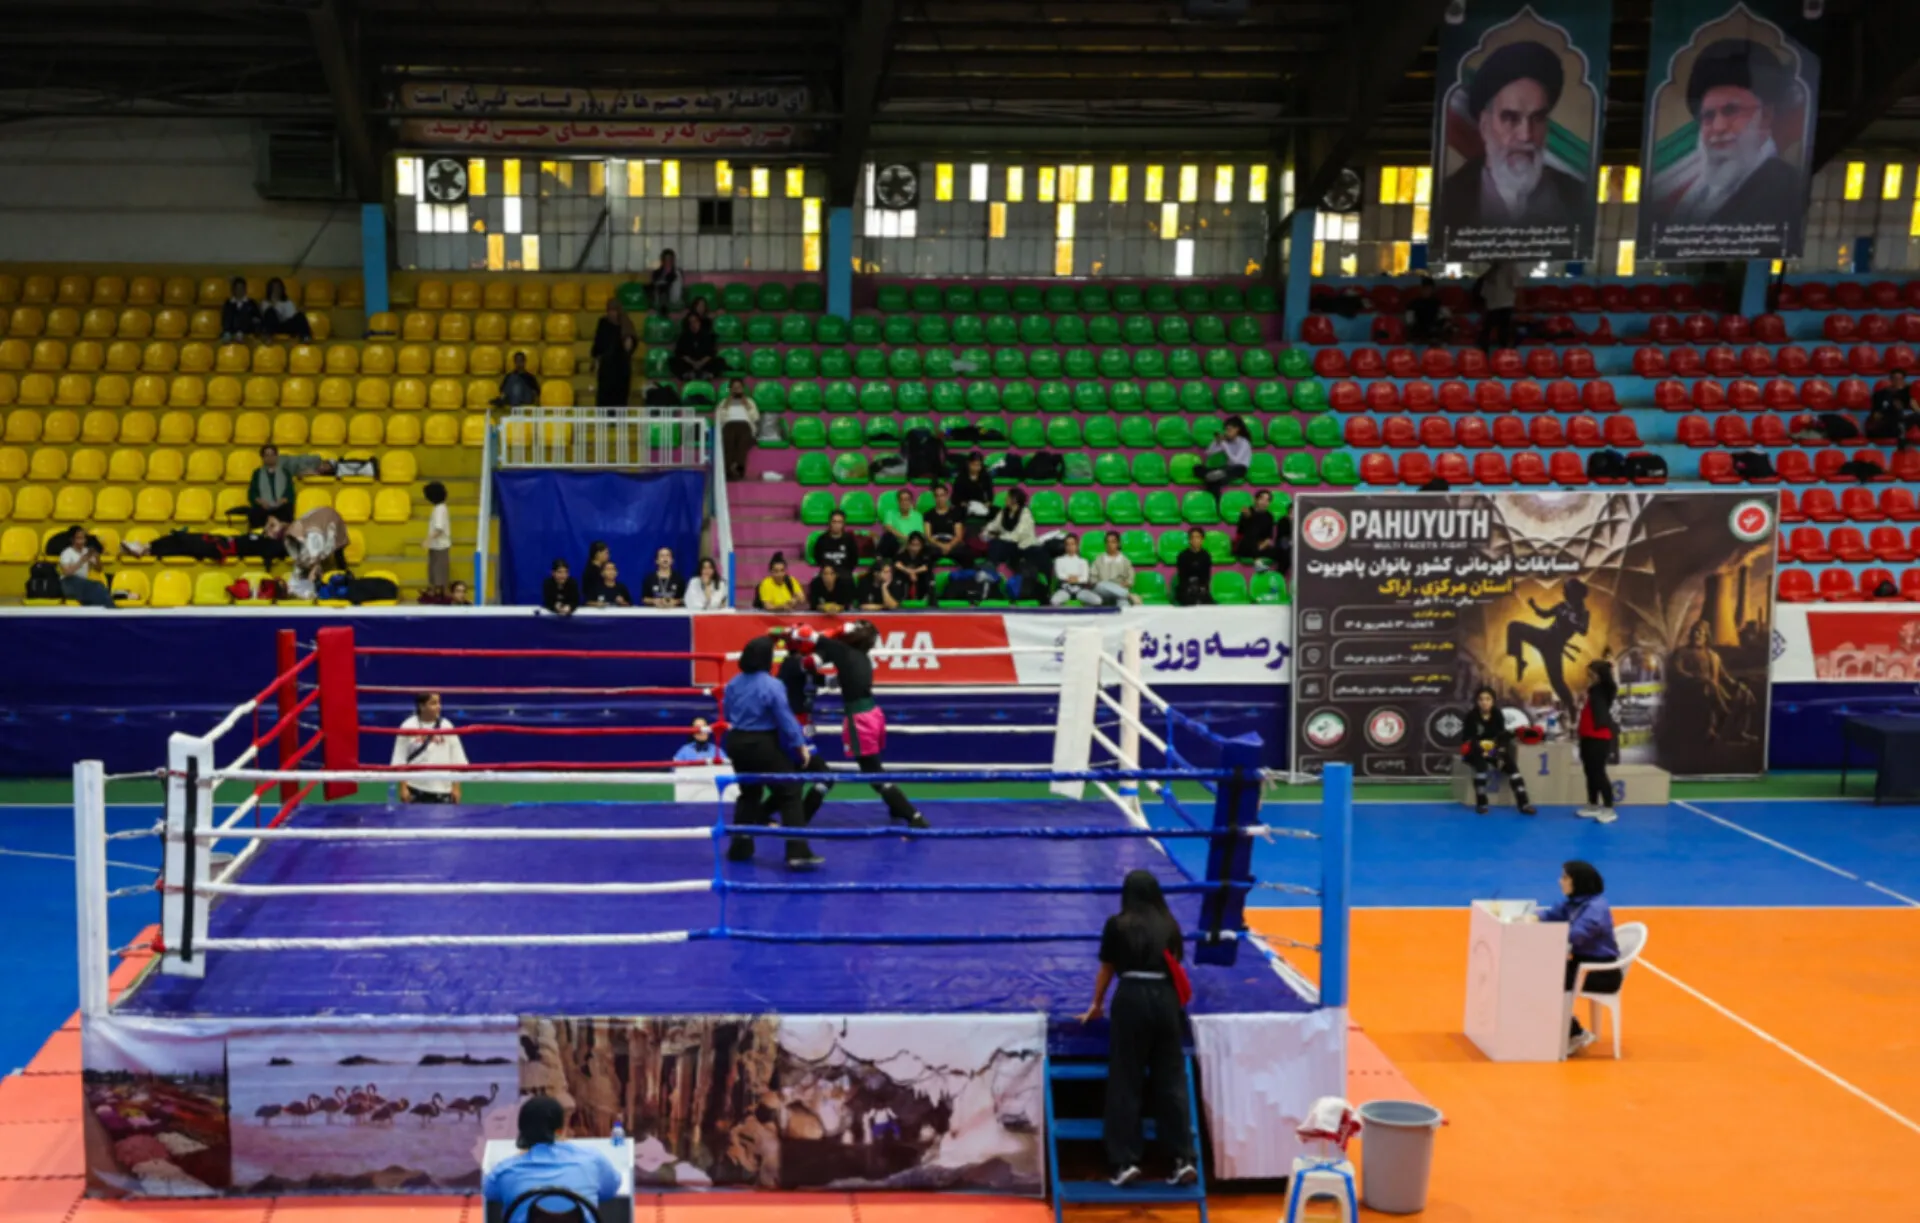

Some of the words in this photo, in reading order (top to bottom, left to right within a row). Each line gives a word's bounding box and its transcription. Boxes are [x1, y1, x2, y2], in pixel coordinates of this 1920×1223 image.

[1349, 509, 1489, 539] PAHUYUTH
[1373, 541, 1401, 549] MULTI
[1404, 541, 1438, 549] FACETS
[1441, 541, 1468, 549] FIGHT
[1306, 556, 1366, 577] پاهویوت
[1368, 556, 1411, 576] بانوان
[1414, 556, 1453, 576] کشور
[1455, 554, 1512, 576] قهرمانی
[1515, 555, 1580, 574] مسابقات
[1378, 577, 1412, 597] اراک
[1420, 578, 1467, 597] مرکزی
[1470, 577, 1513, 596] استان
[1117, 631, 1201, 671] ورزش
[1205, 631, 1292, 670] رصه
[1537, 751, 1550, 775] 1
[1611, 780, 1626, 802] 3
